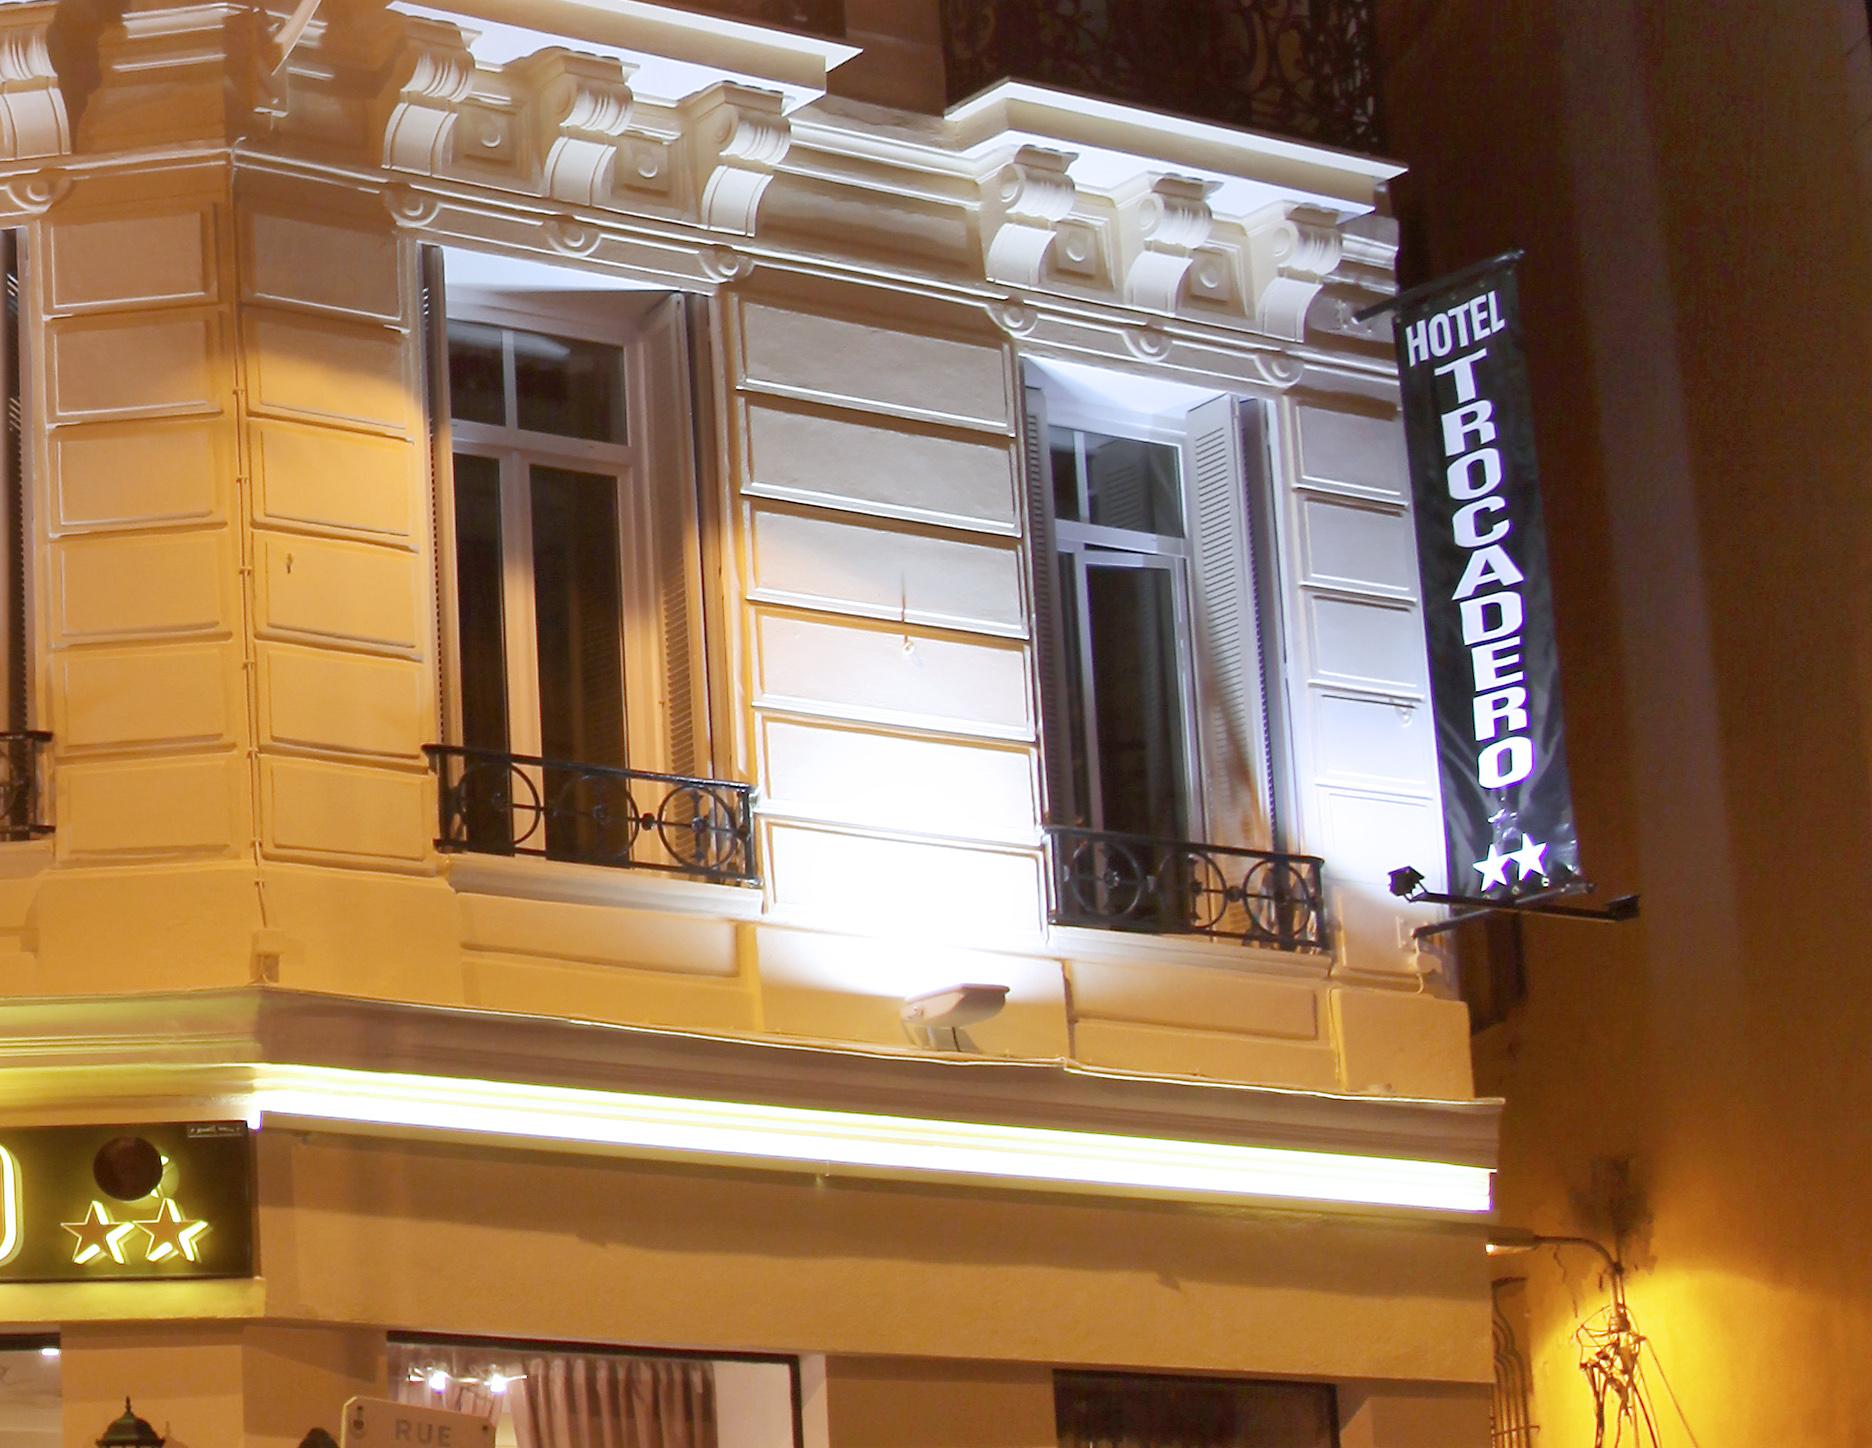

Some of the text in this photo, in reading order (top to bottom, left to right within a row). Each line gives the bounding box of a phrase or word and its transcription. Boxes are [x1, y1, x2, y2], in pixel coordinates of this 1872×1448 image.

[1406, 291, 1505, 367] HOTEL
[1434, 348, 1535, 789] TROCADERO
[395, 1419, 452, 1447] RUE
